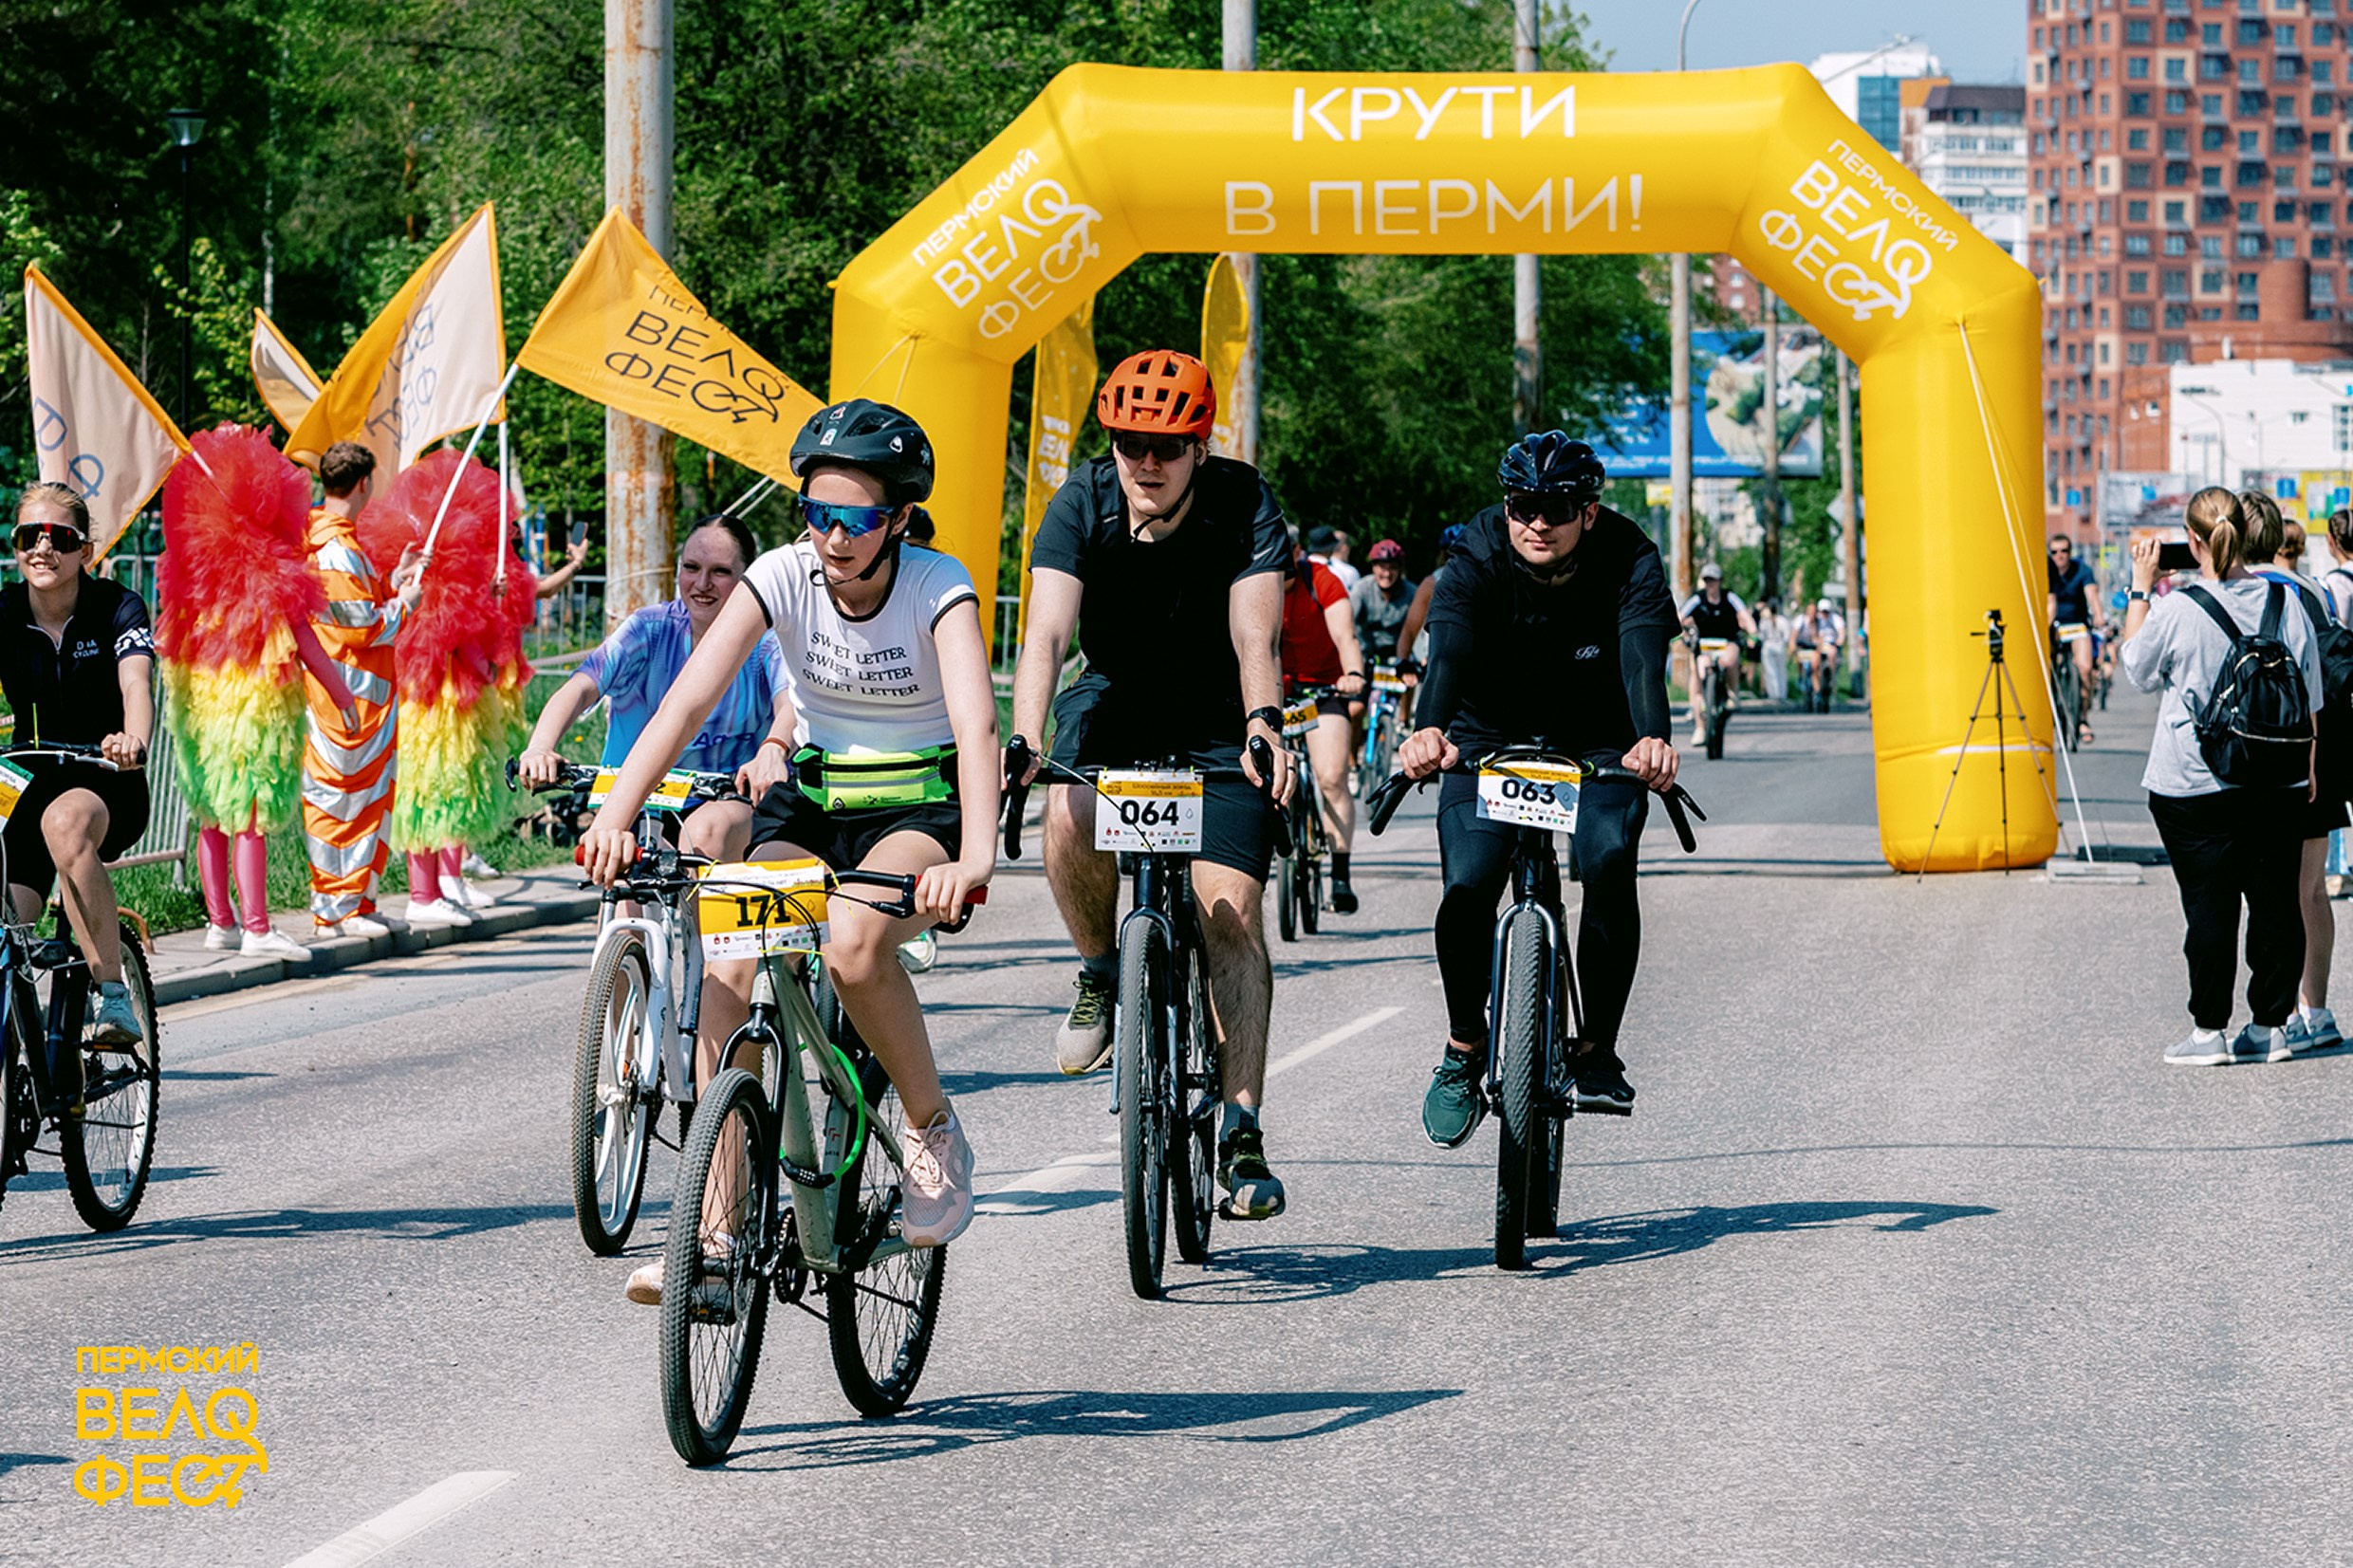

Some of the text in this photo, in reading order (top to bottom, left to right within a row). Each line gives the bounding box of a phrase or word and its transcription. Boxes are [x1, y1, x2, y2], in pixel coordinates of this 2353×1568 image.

[1292, 84, 1576, 141] КРУТИ
[911, 148, 1040, 267] ПЕРМСКИЙ
[1225, 174, 1643, 235] В ПЕРМИ!
[1789, 159, 1933, 286] ВЕЛО
[1827, 138, 1958, 252] ПЕРМСКИЙ
[931, 178, 1070, 309] ВЕЛО
[624, 310, 786, 400] ВЕЛО
[811, 631, 907, 665] SWET LETTER
[859, 666, 914, 681] LETTER
[803, 668, 920, 697] SWEET LETTER
[1120, 800, 1179, 826] 064
[1501, 779, 1557, 805] 063
[735, 893, 791, 928] 171
